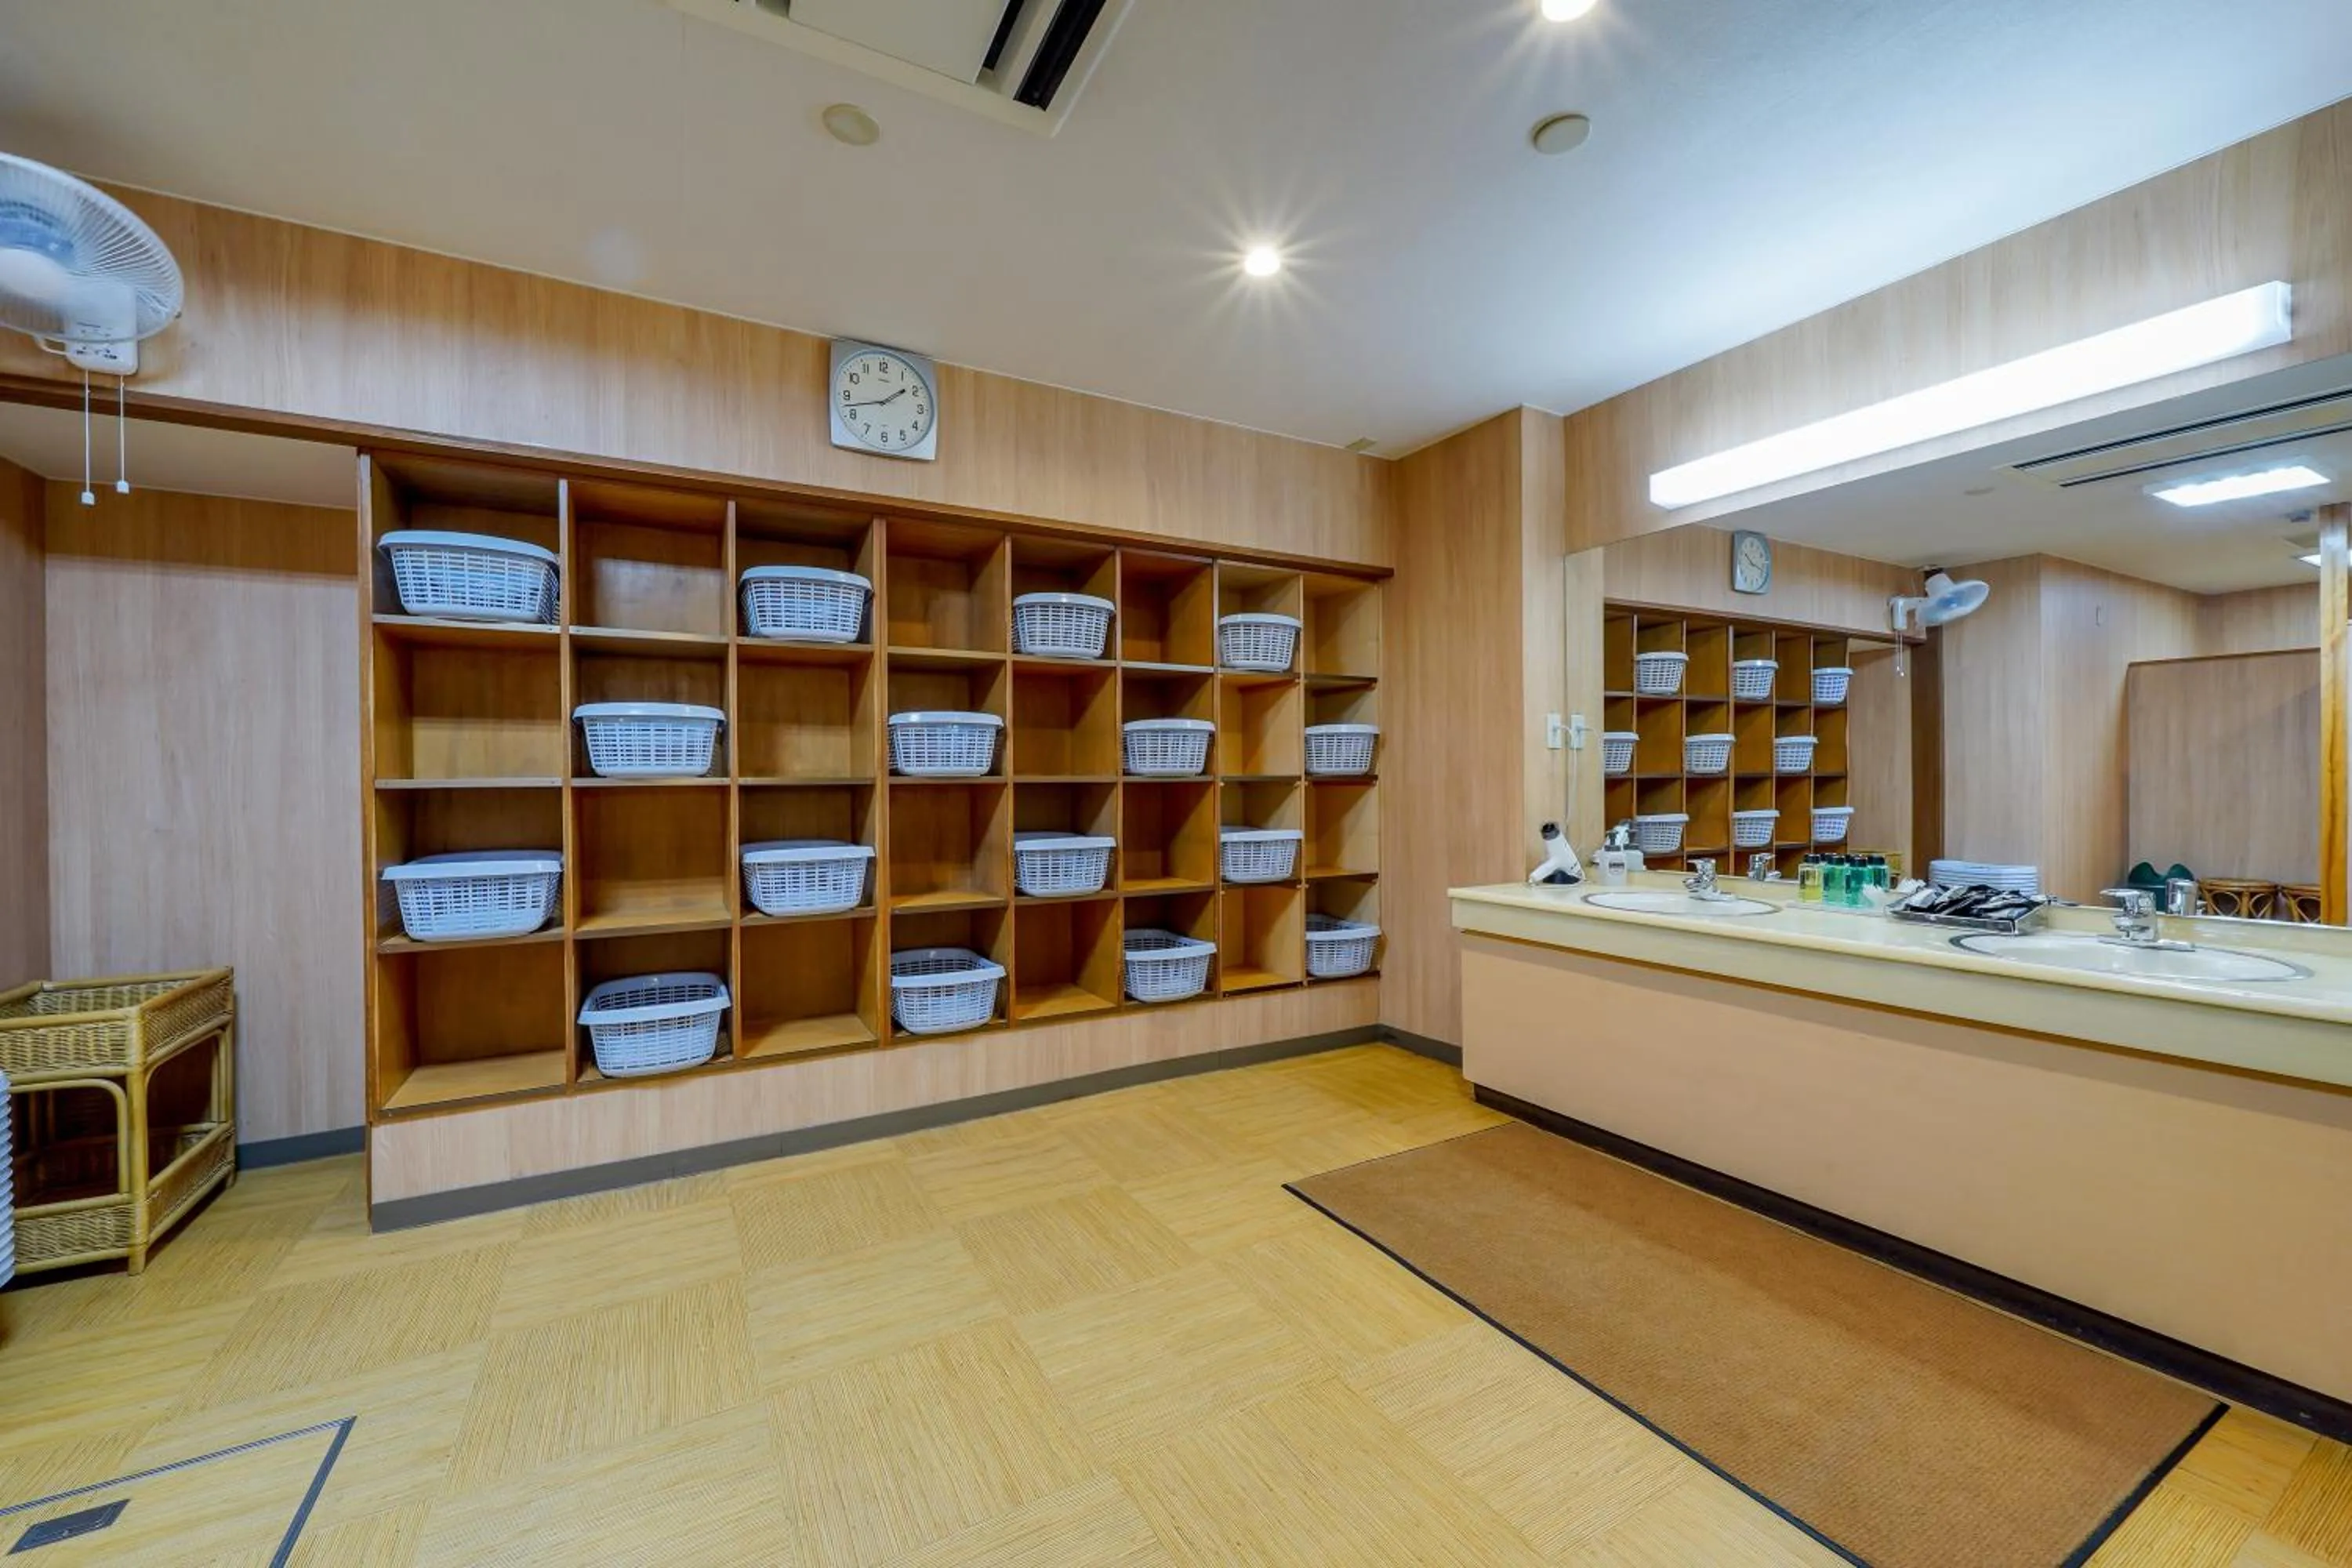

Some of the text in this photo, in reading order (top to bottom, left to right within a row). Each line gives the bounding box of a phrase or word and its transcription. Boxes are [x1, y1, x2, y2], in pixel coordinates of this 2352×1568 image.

[862, 363, 869, 375] 11
[879, 361, 888, 374] 12
[849, 372, 860, 385] 10
[843, 390, 851, 401] 9
[912, 385, 919, 397] 2
[849, 408, 857, 420] 8
[916, 404, 924, 415] 3
[864, 423, 872, 434] 7
[912, 420, 918, 431] 4
[880, 432, 888, 443] 6
[899, 430, 907, 441] 5
